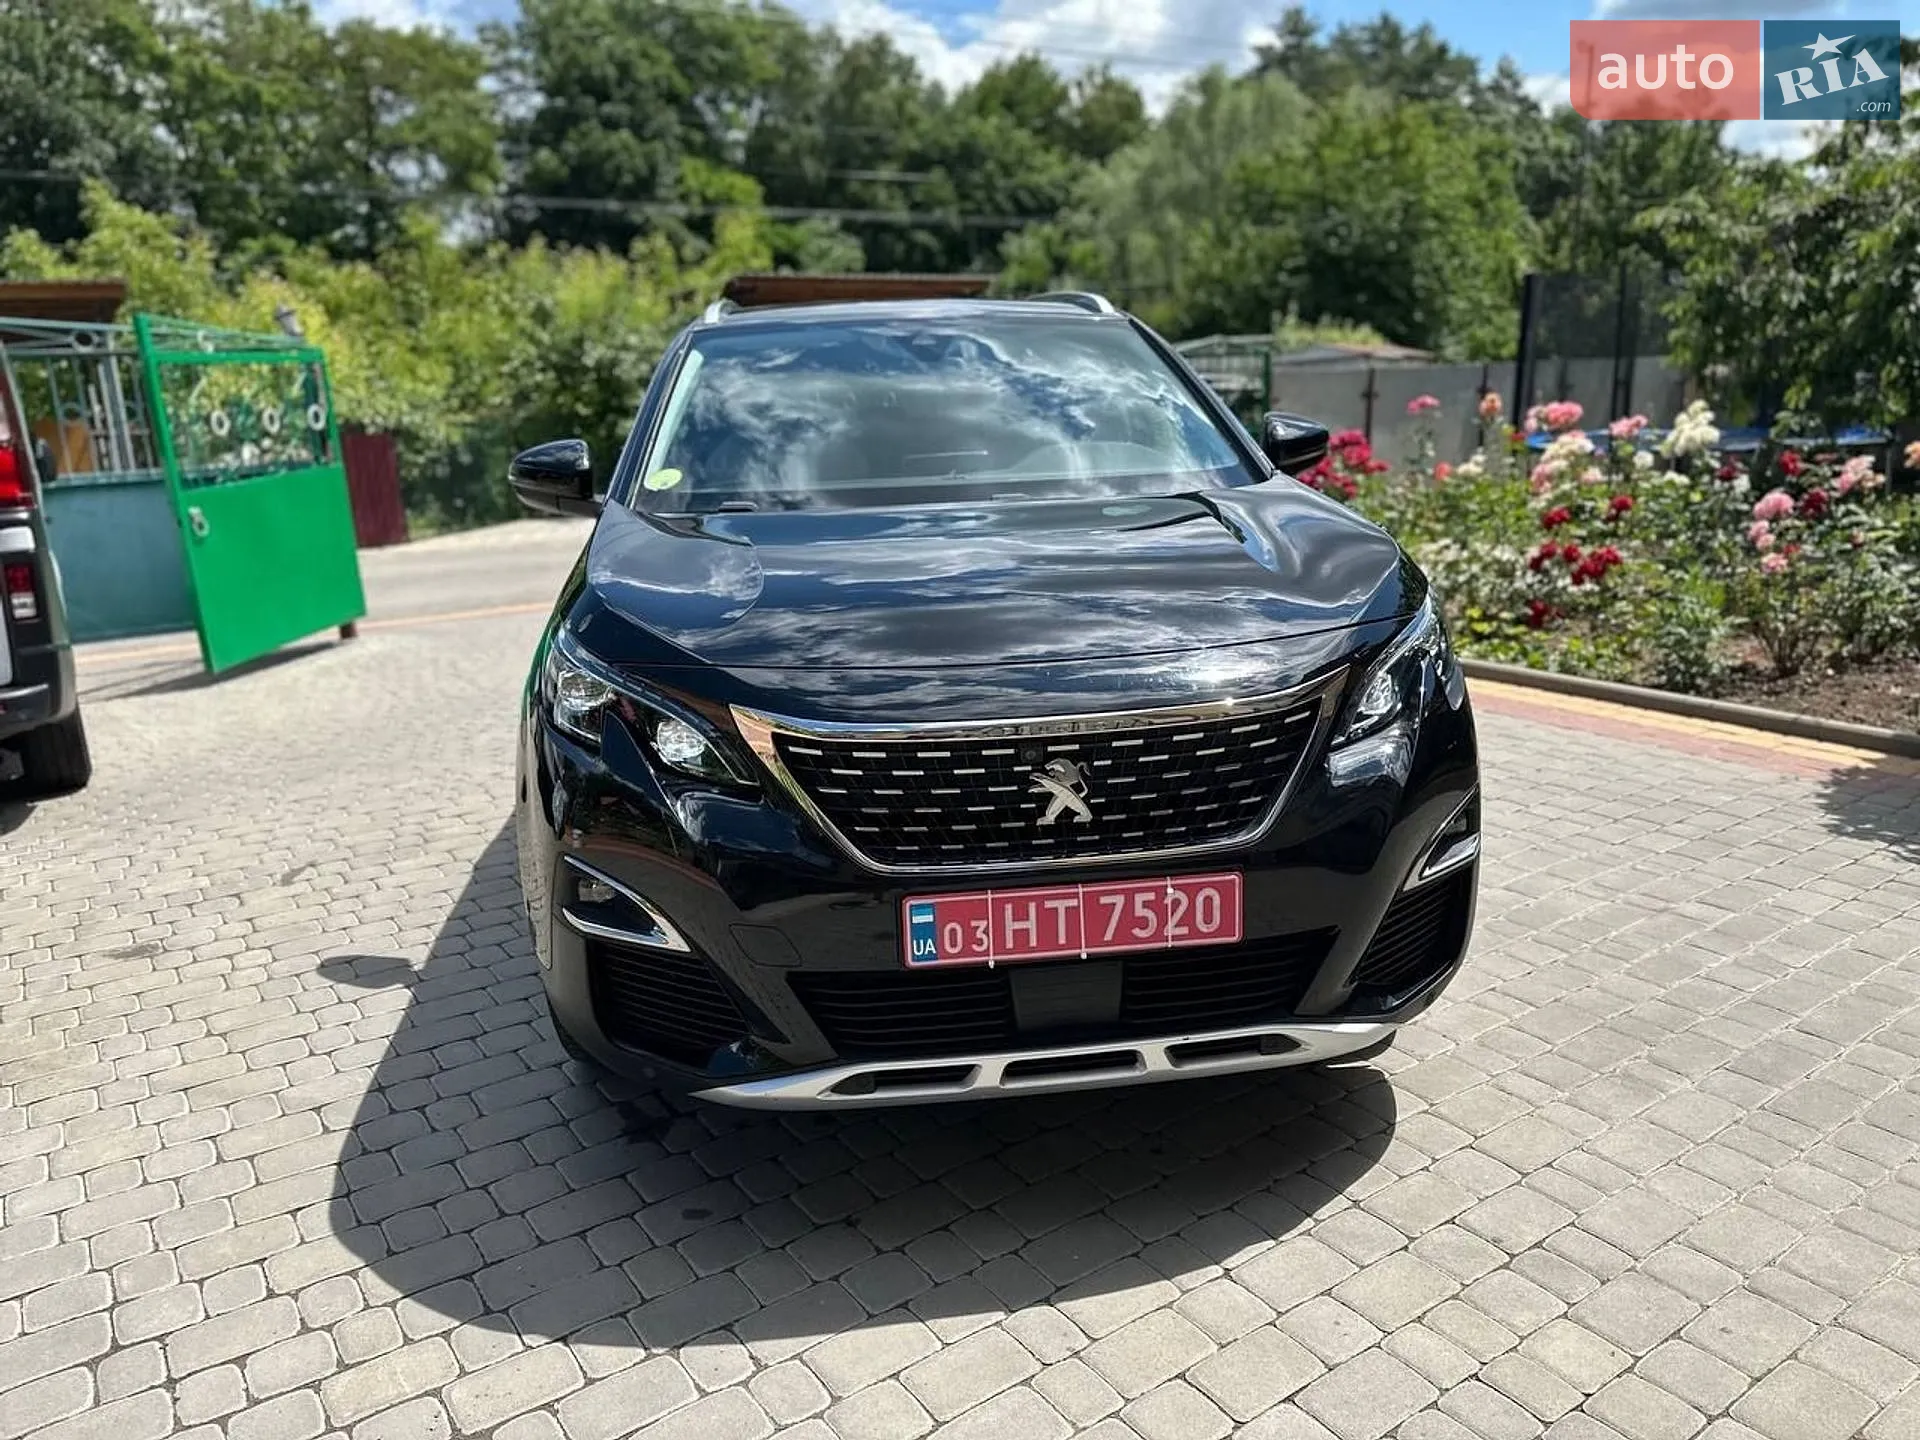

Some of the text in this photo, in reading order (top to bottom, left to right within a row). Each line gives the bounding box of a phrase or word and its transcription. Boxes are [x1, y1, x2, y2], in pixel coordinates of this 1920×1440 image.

[943, 887, 1221, 954] 03 HT 7520
[912, 938, 937, 956] UA
